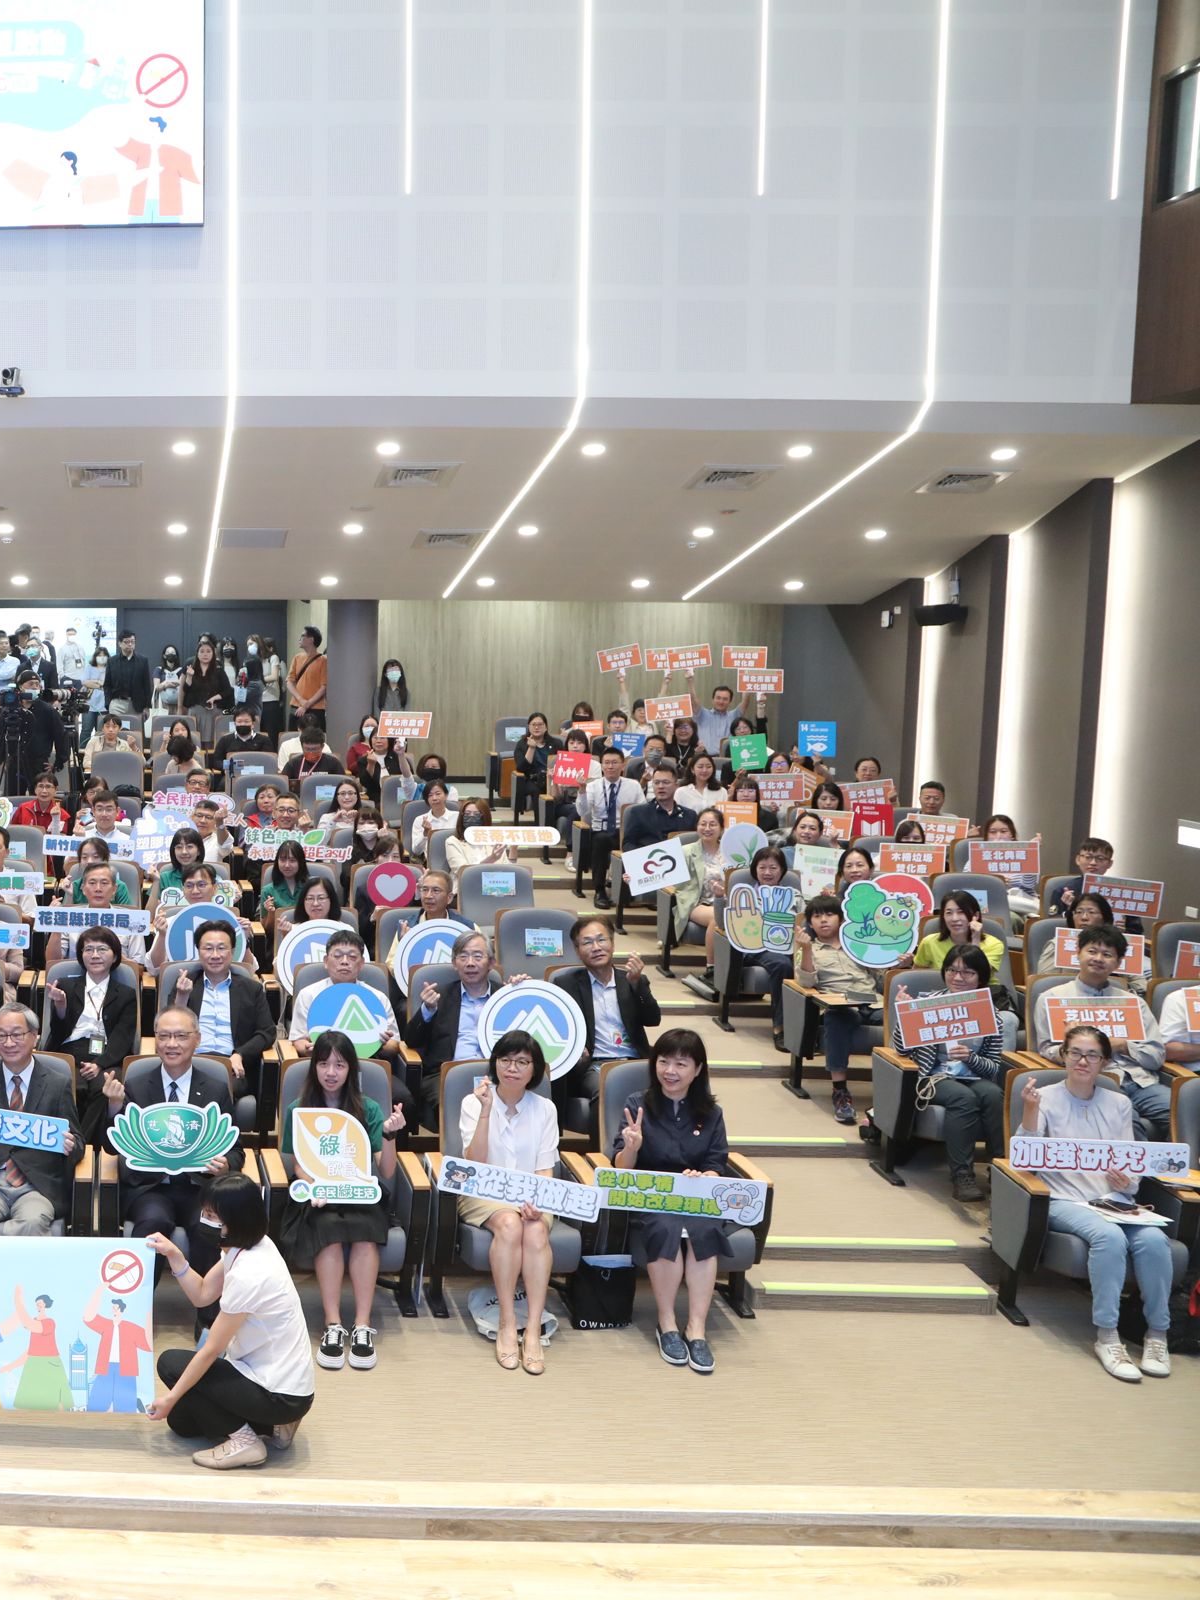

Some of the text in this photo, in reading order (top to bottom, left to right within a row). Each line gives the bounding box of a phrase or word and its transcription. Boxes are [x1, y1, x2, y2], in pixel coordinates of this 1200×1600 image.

[800, 723, 809, 732] 14
[731, 738, 739, 747] 15
[855, 805, 861, 815] 4
[38, 910, 130, 929] 花蓮縣環保局
[922, 1007, 970, 1026] 陽明山
[1064, 1009, 1125, 1023] 芝山文化
[918, 1020, 980, 1042] 國家公園
[1012, 1139, 1146, 1174] 加強研究
[597, 1169, 675, 1193] 從小事情
[314, 1183, 376, 1200] 全民綠生活
[475, 1166, 599, 1220] 從我做起
